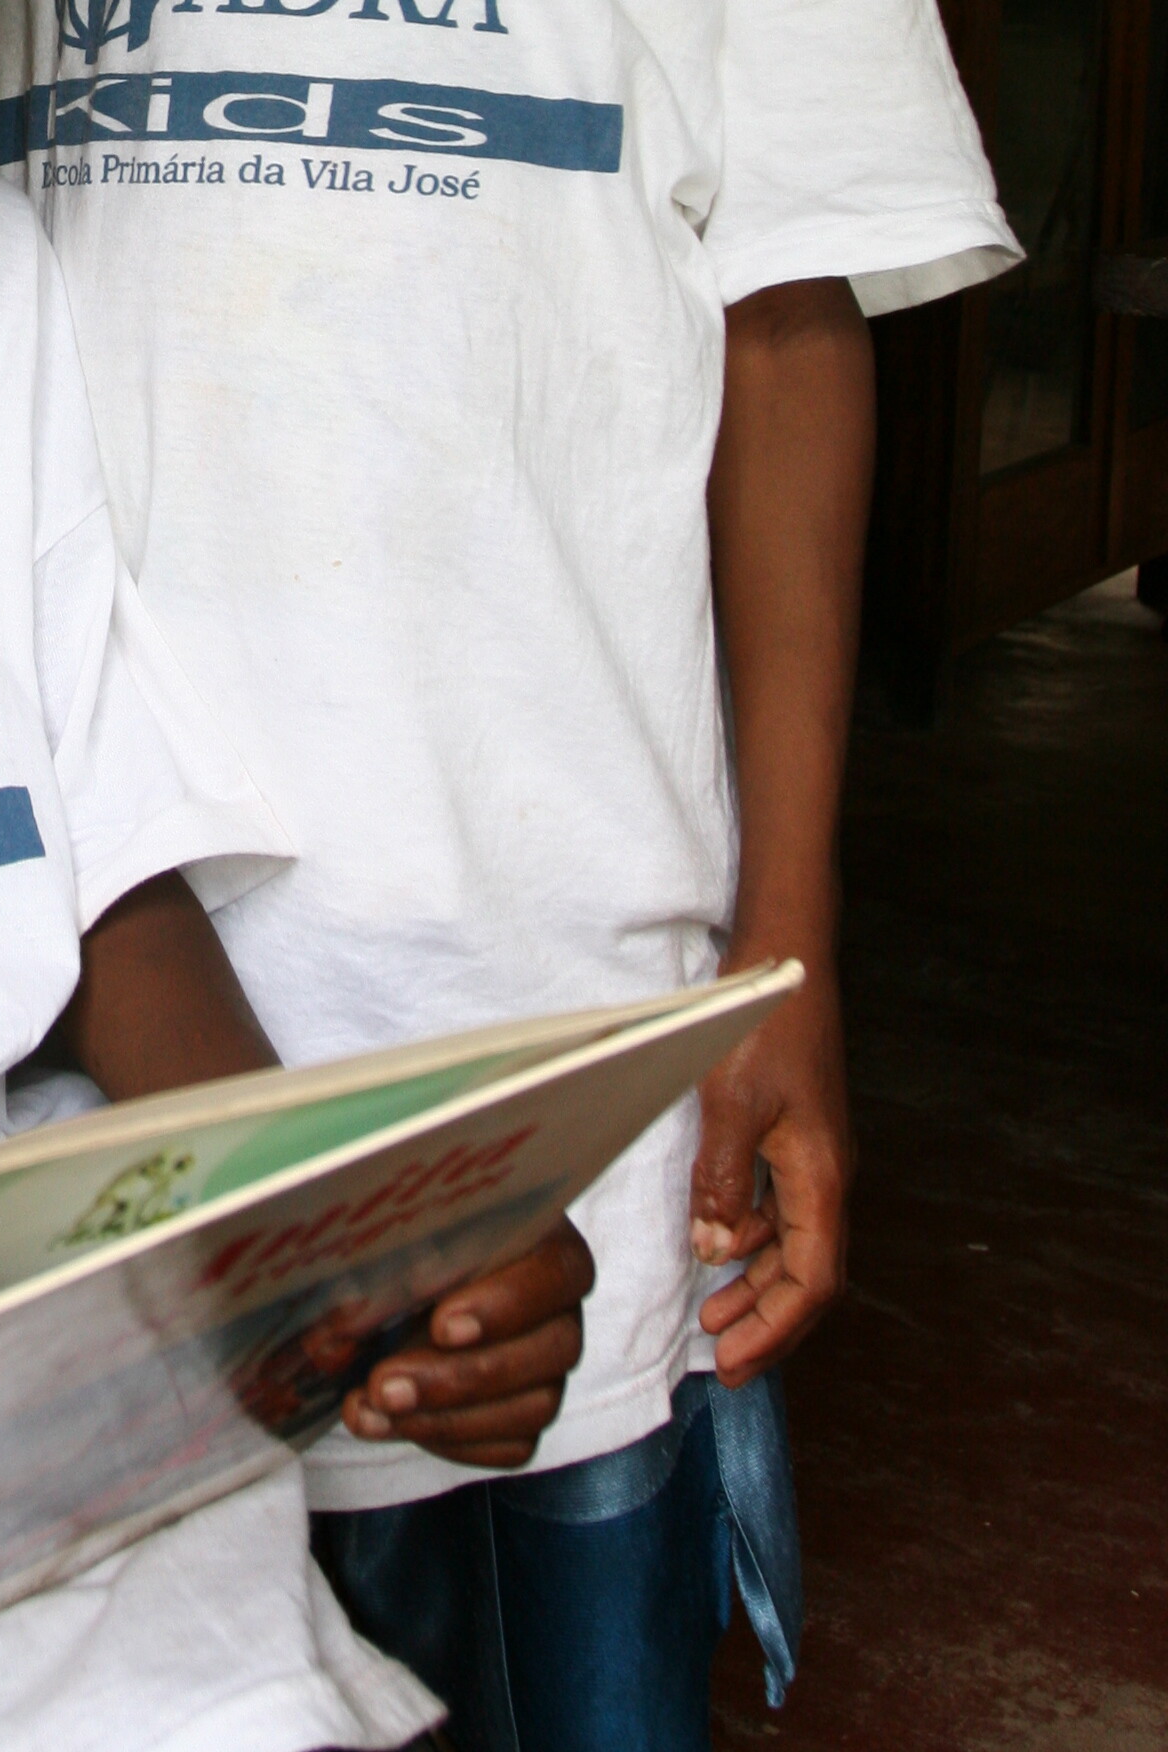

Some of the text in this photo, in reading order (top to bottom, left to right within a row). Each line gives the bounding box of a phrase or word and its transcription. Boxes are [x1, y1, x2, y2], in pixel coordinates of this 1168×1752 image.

[46, 77, 488, 147] Kids
[100, 153, 226, 185] Primária
[238, 154, 286, 187] da
[302, 158, 375, 193] Vila
[388, 164, 482, 199] José
